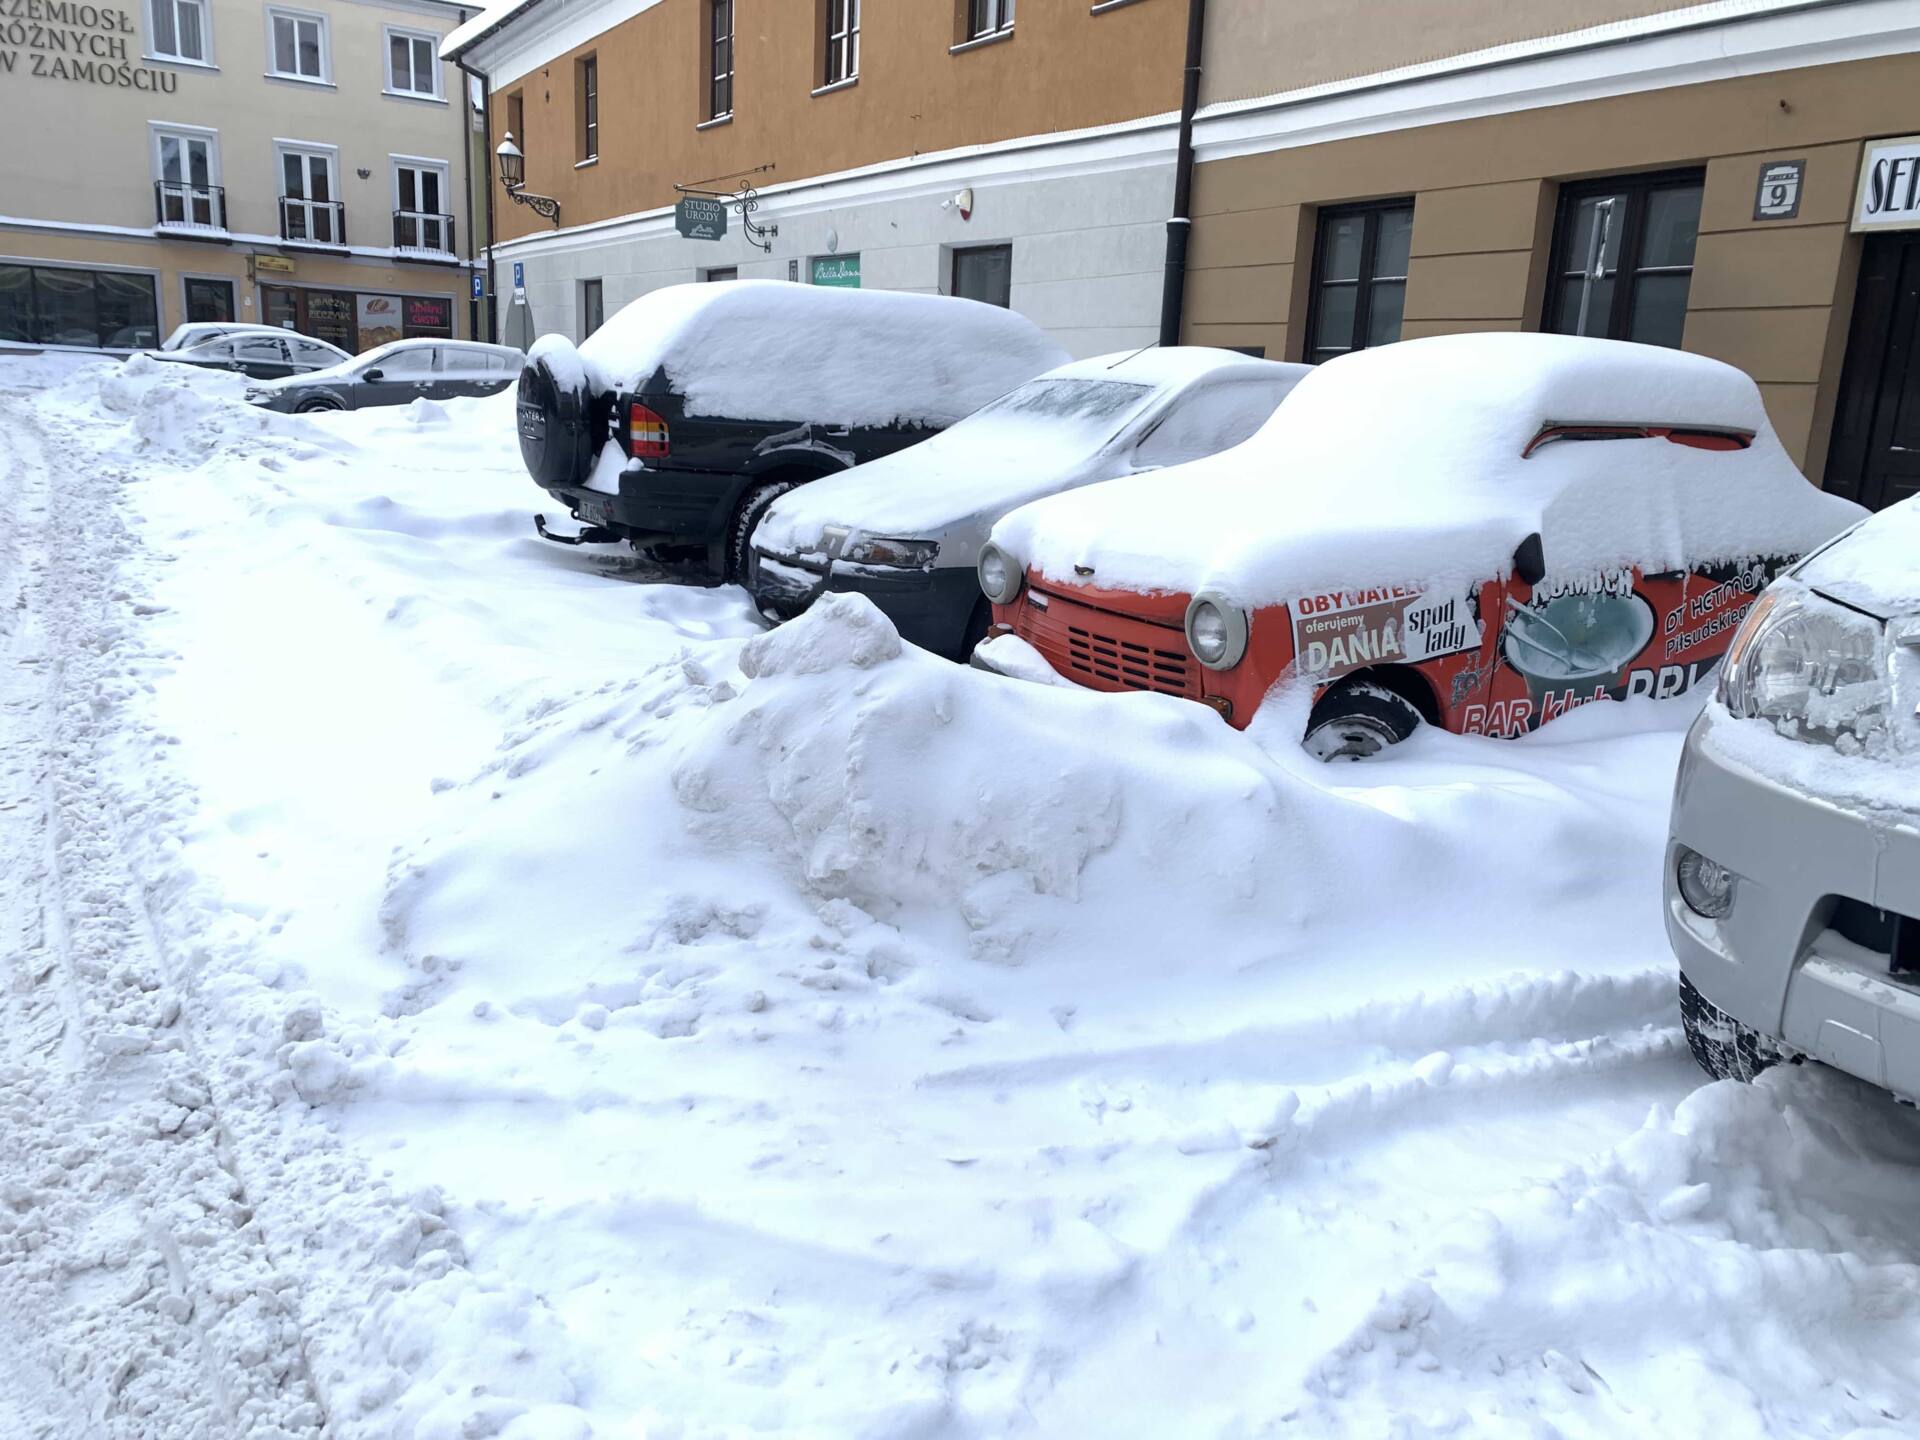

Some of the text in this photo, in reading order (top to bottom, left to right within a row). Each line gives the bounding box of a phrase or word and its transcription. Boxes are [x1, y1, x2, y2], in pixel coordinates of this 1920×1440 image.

[30, 53, 177, 93] ZAMOŚCIU
[1771, 184, 1787, 207] 9
[1867, 156, 1920, 215] SET
[684, 199, 720, 212] STUDIO
[685, 210, 719, 222] URODY
[474, 278, 481, 294] P
[1305, 615, 1365, 634] oferujemy
[1409, 597, 1455, 634] spod
[1308, 629, 1400, 673] DANIA
[1425, 623, 1467, 654] lady
[1461, 697, 1533, 738] BAR
